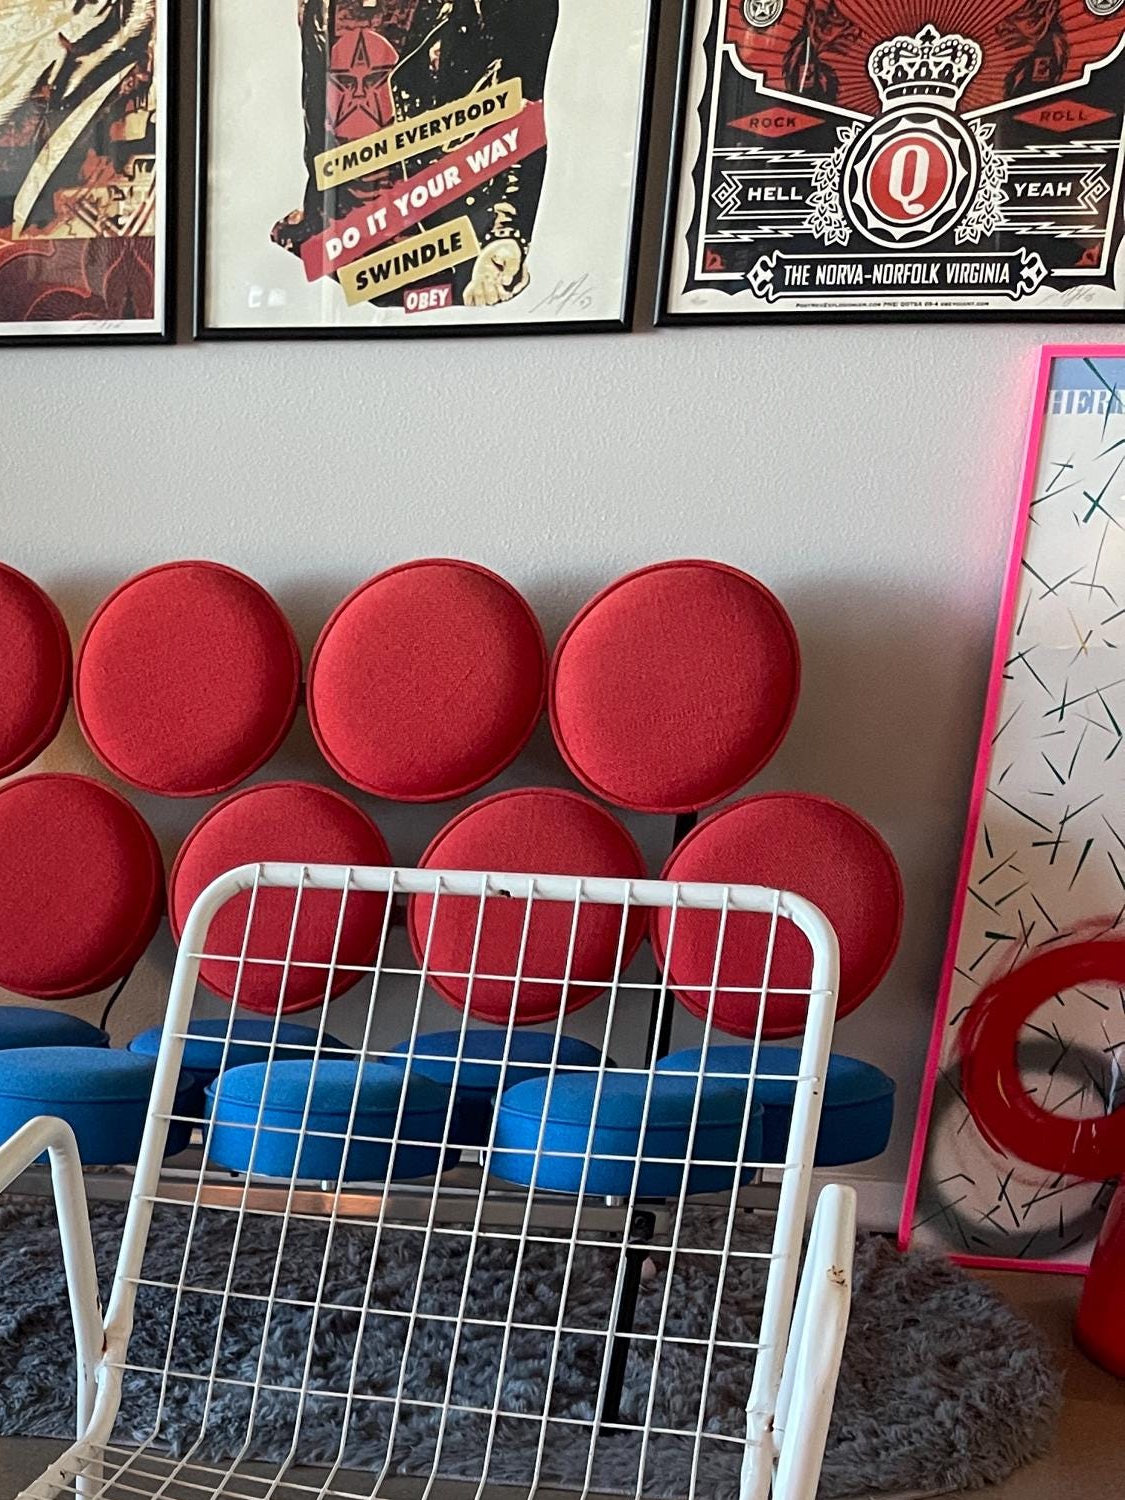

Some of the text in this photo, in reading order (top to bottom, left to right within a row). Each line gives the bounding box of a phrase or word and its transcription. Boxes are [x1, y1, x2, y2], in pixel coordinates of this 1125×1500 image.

[748, 115, 797, 129] ROCK
[1039, 108, 1089, 122] ROLL
[323, 92, 508, 177] C'MON EVERYBODY
[887, 144, 930, 215] Q
[1013, 182, 1073, 198] YEAH
[325, 128, 520, 261] DO IT YOUR WAY
[747, 186, 803, 201] HELL
[356, 232, 462, 291] SWINDLE
[783, 262, 1010, 286] THE NORVA-NORFOLK VIRGINIA
[406, 287, 452, 310] OBEY
